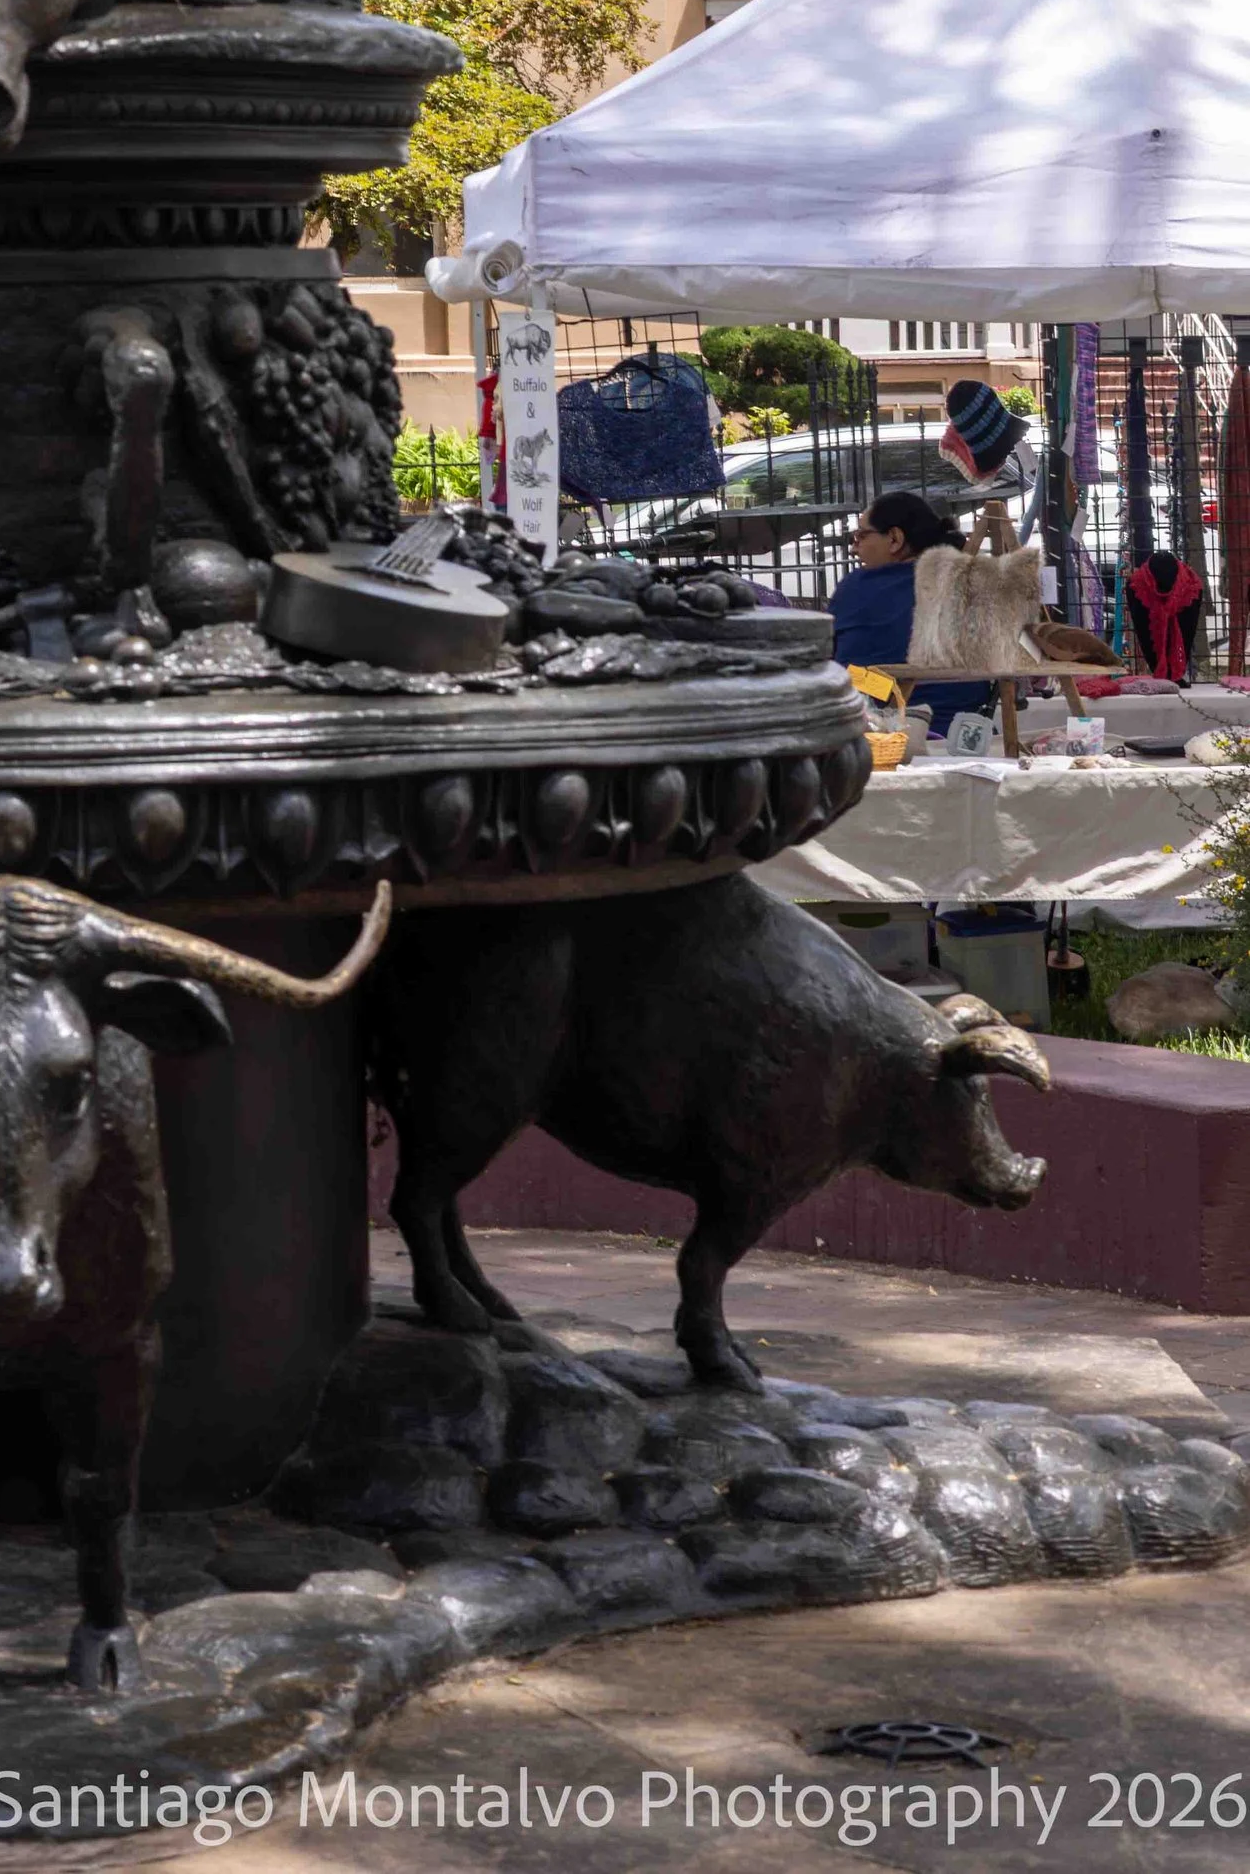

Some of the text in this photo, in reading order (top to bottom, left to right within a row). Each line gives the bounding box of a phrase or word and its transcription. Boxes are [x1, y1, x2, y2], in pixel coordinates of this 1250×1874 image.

[513, 376, 547, 392] Buffalo
[526, 401, 535, 418] &
[521, 497, 543, 511] Wolf
[523, 519, 540, 533] Hair
